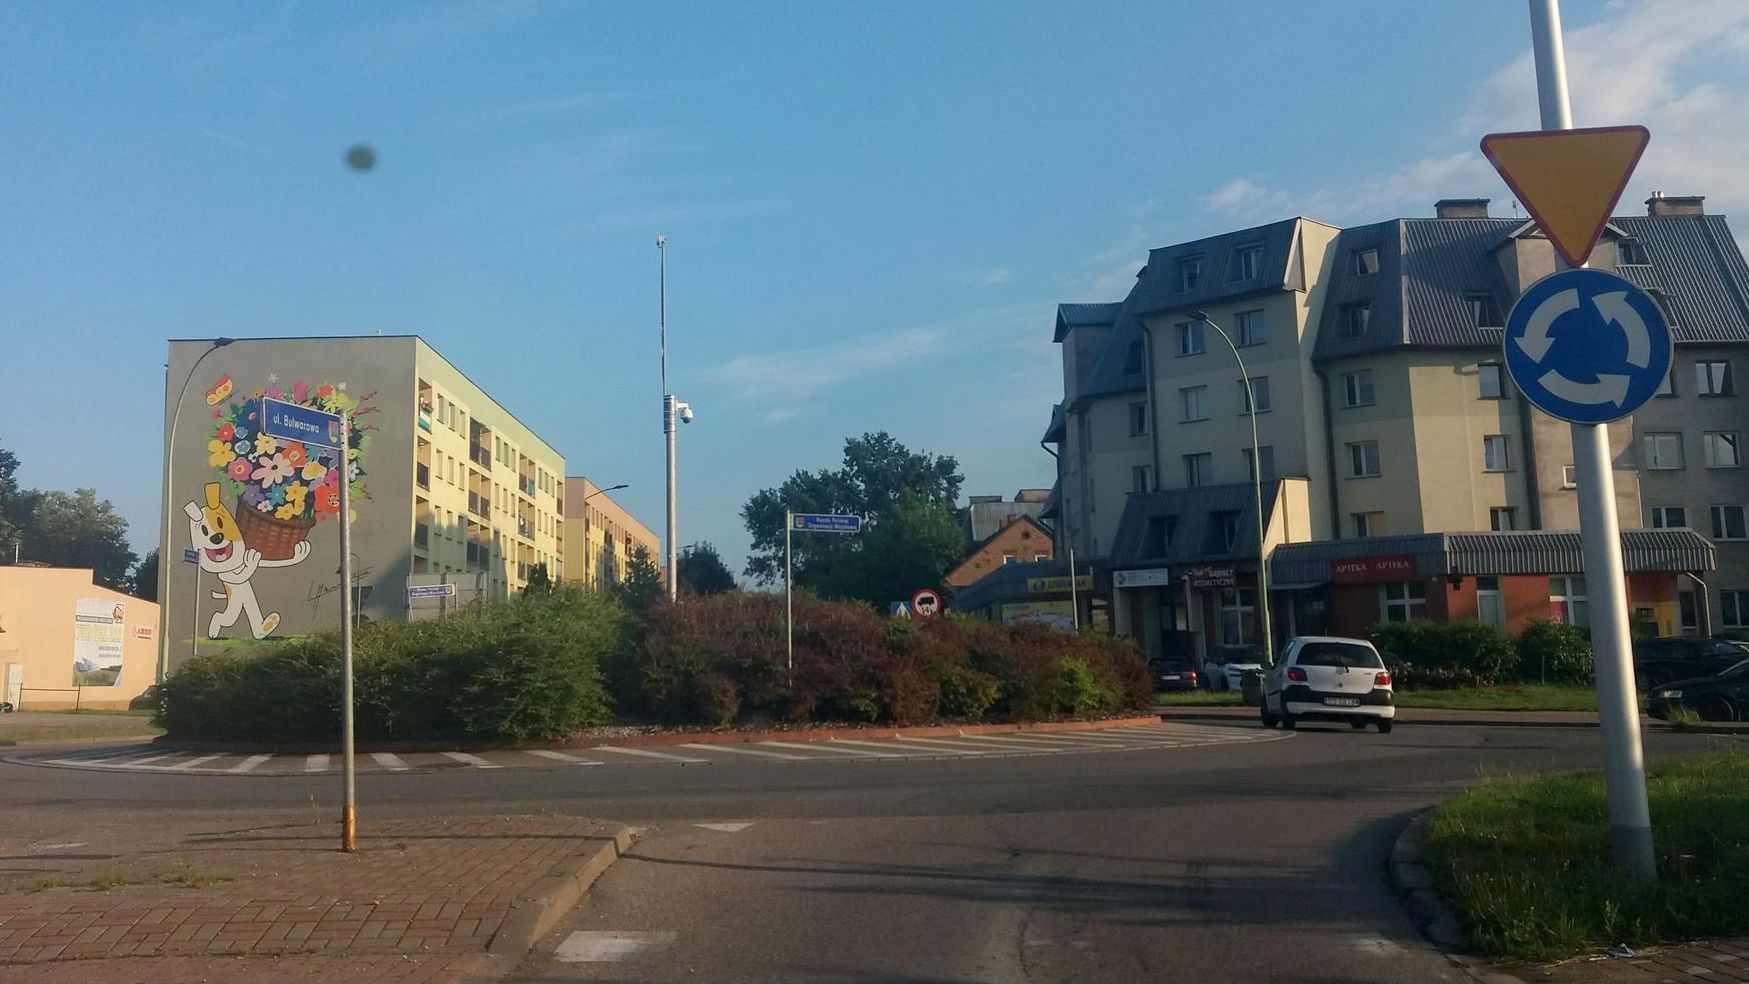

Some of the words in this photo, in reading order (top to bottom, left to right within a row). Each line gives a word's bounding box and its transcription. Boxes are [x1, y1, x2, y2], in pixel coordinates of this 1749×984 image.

[273, 413, 282, 425] ul.
[284, 415, 320, 433] Bulwarowa
[1336, 563, 1367, 573] APTEKA
[1376, 559, 1410, 569] APTEKA
